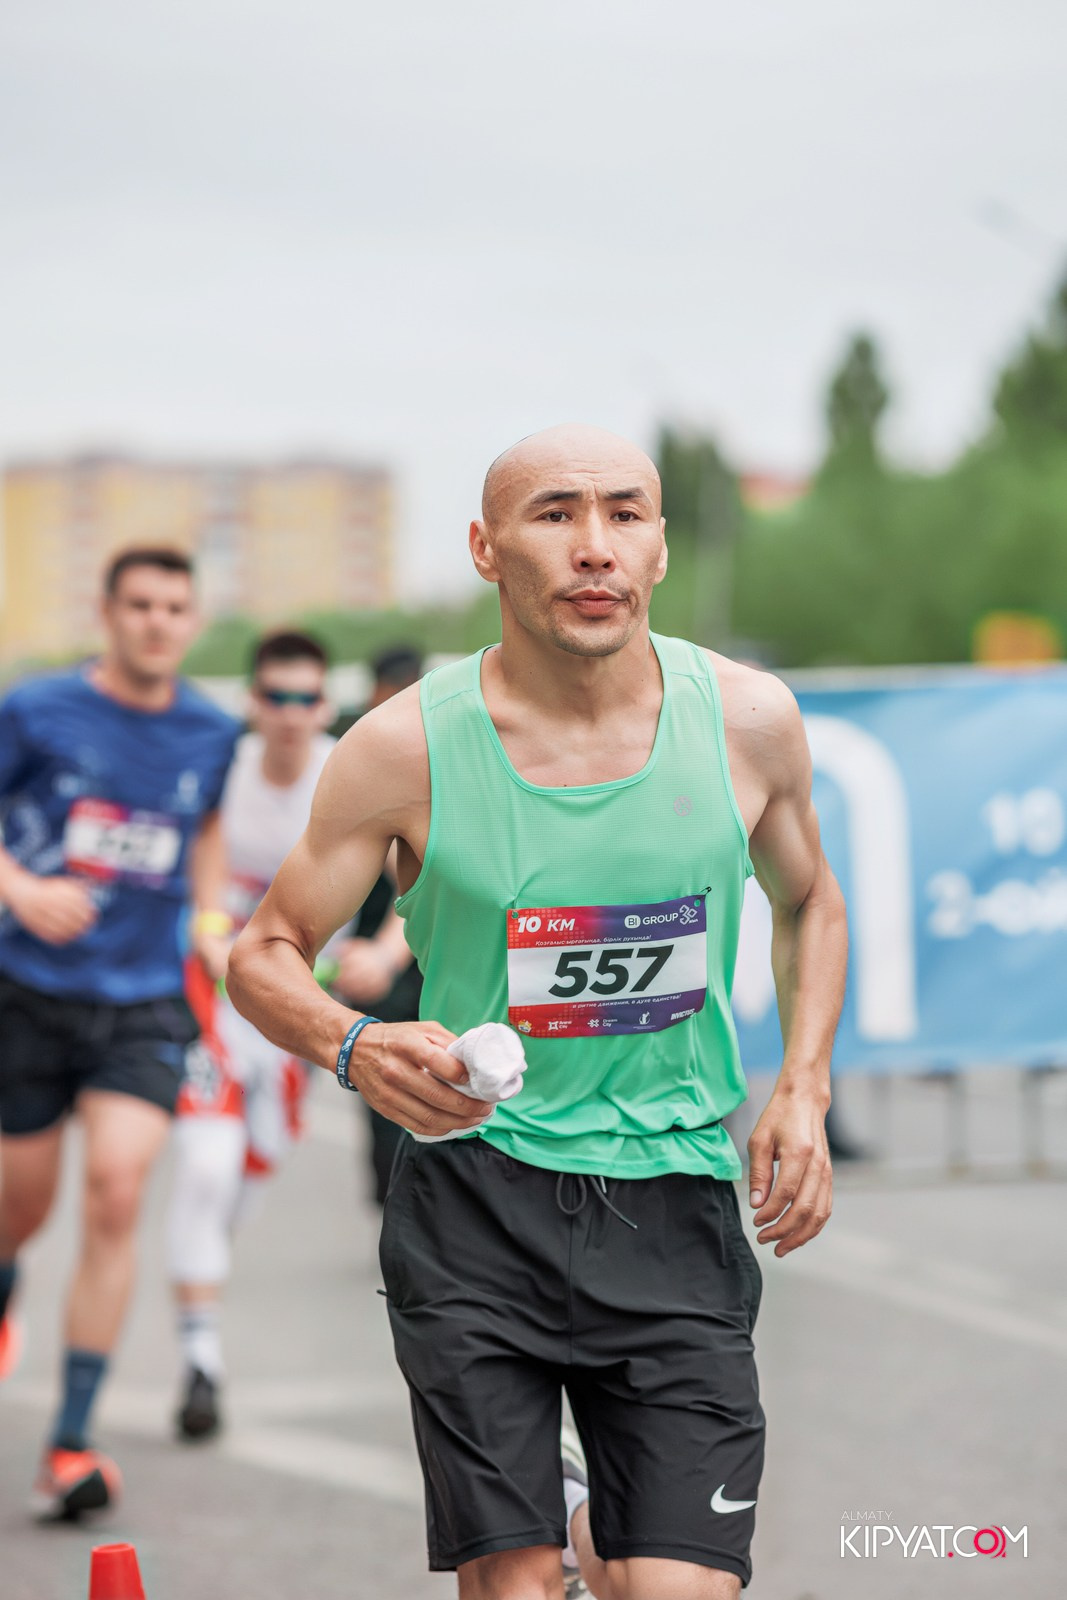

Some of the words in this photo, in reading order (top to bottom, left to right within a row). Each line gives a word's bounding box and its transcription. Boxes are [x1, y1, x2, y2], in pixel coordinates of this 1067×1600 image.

[517, 916, 542, 933] 10
[642, 912, 679, 925] GROUP
[548, 944, 674, 998] 557
